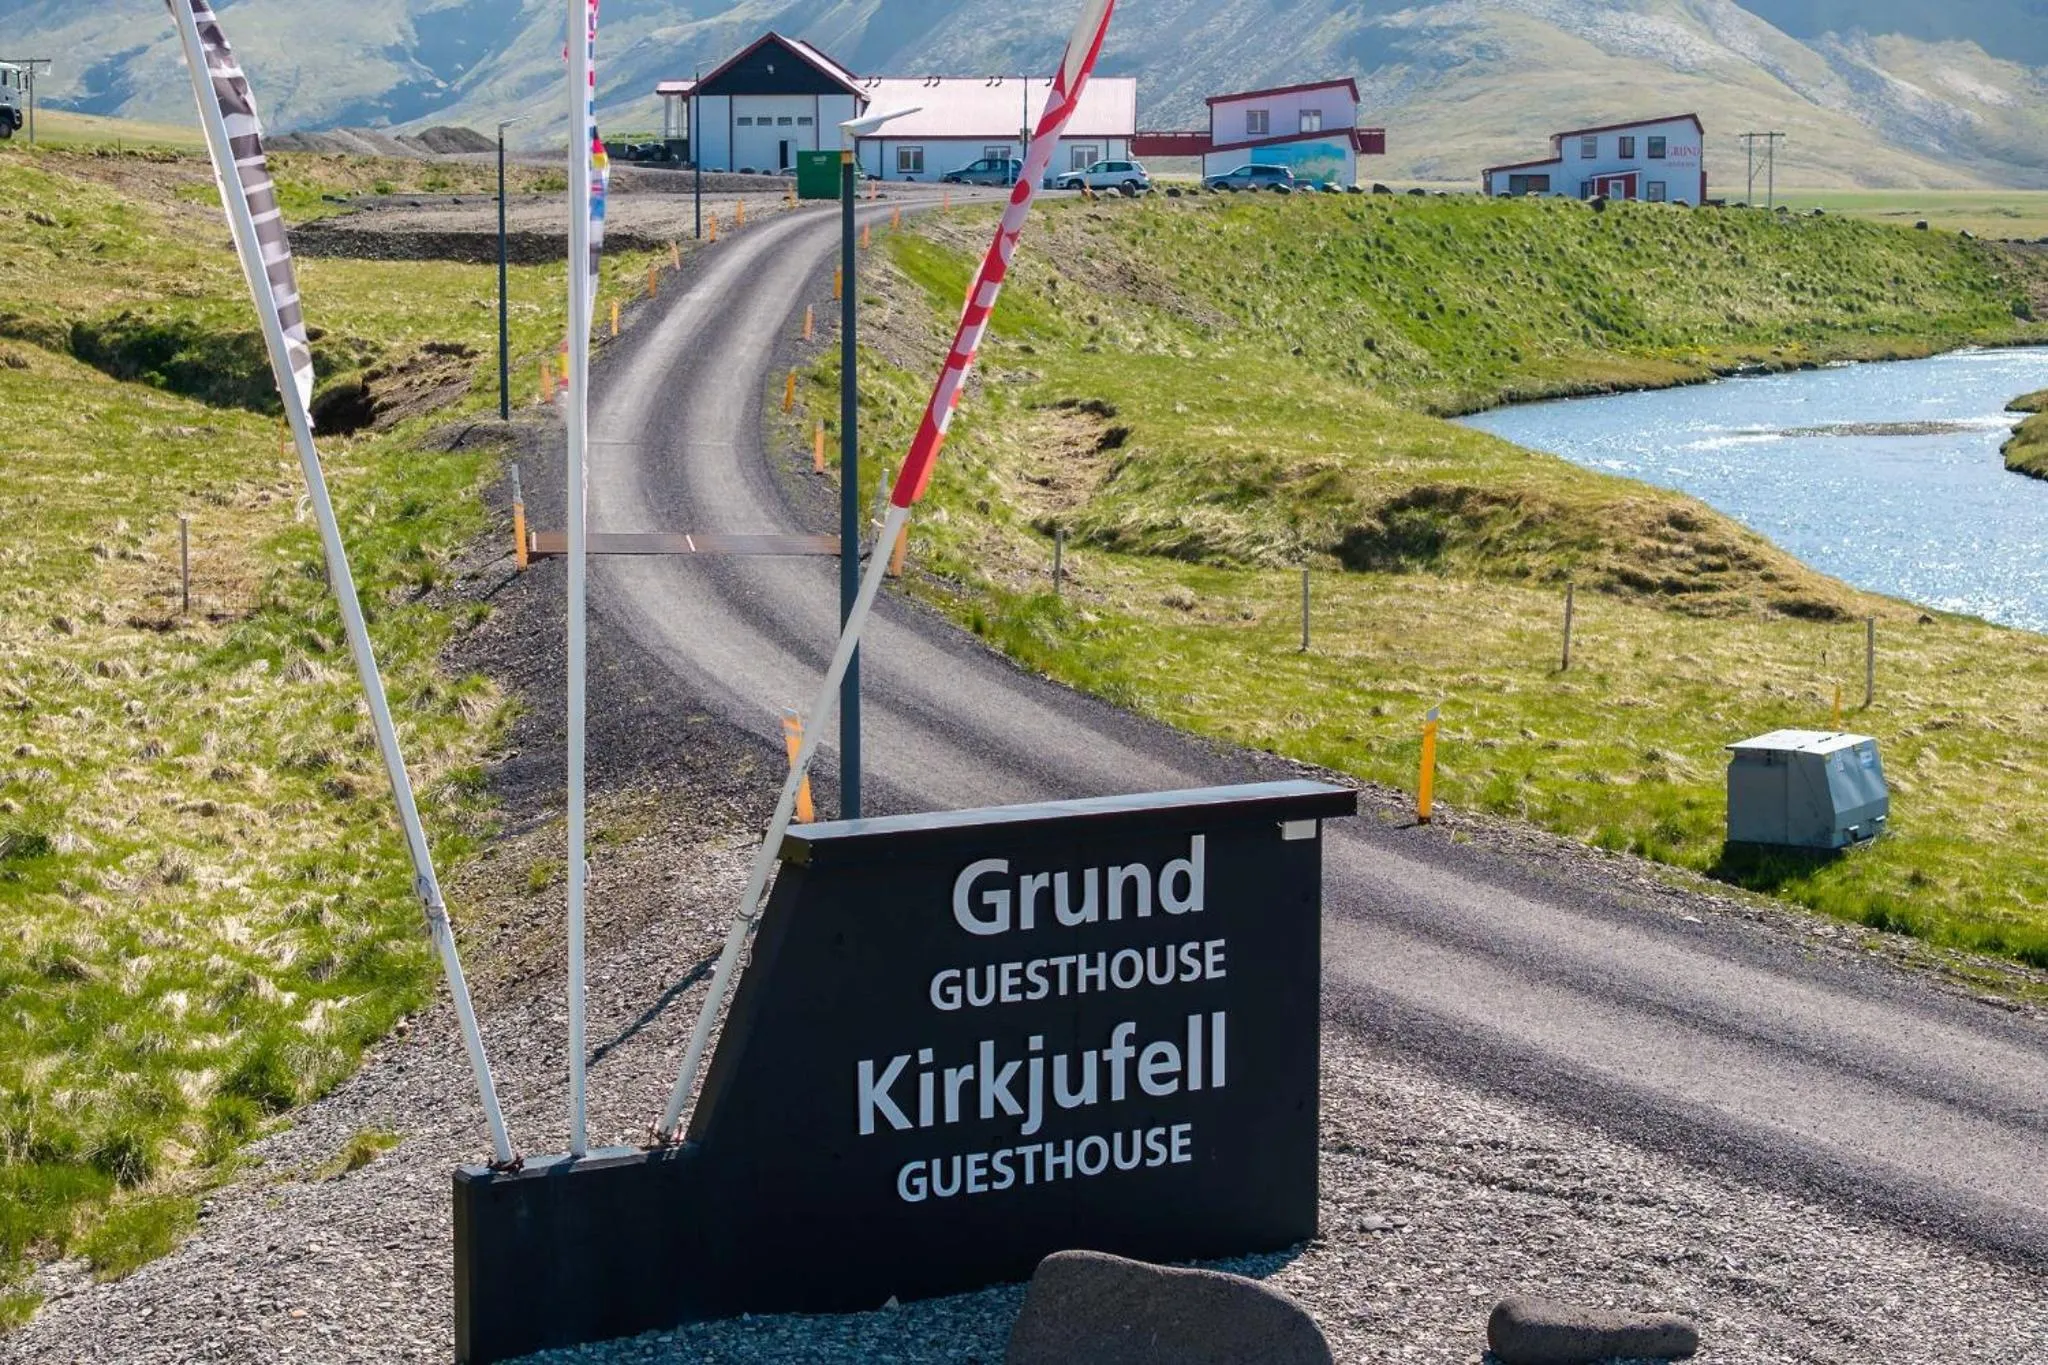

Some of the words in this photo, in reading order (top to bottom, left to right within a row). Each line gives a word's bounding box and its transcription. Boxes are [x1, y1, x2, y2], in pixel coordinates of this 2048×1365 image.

[953, 835, 1205, 935] Grund
[930, 938, 1226, 1011] GUESTHOUSE
[857, 1012, 1226, 1135] Kirkjufell
[897, 1123, 1192, 1202] GUESTHOUSE
